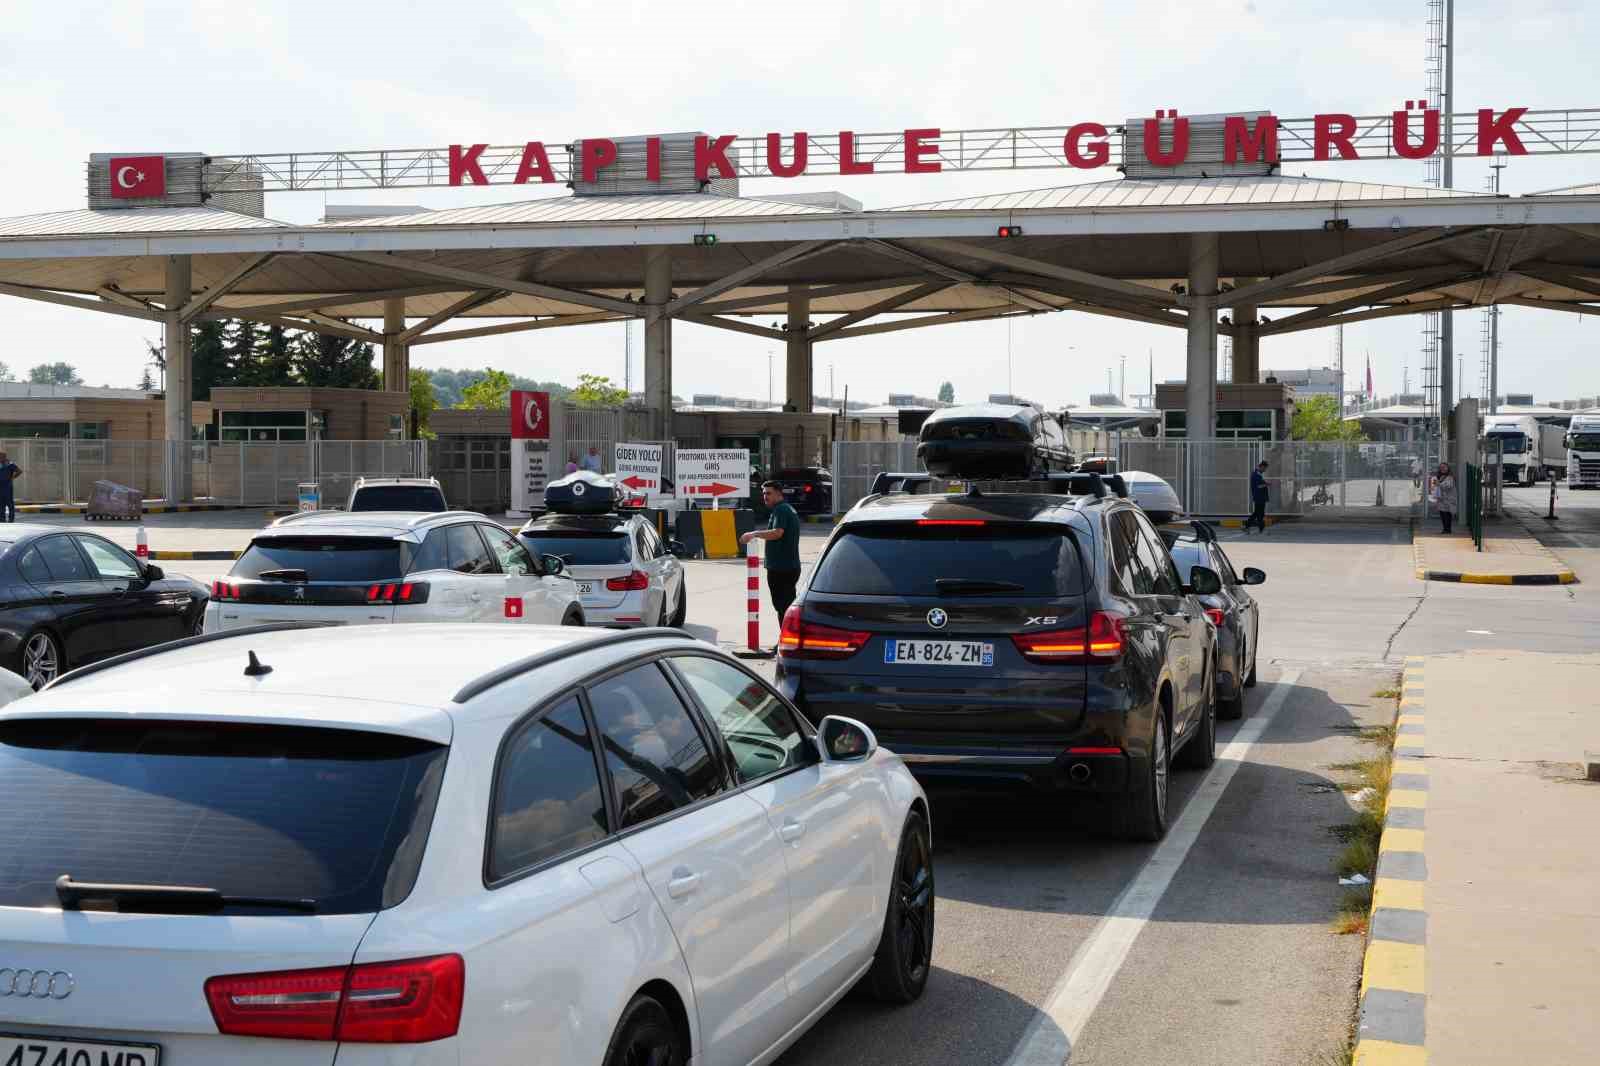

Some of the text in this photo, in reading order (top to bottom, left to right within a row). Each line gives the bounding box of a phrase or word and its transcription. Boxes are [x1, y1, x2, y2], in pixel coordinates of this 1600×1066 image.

[448, 100, 1528, 186] KAPIKULE GÜMRÜK
[638, 448, 661, 462] YOLCU
[1023, 616, 1057, 626] X5
[897, 642, 982, 663] EA-824-ZM
